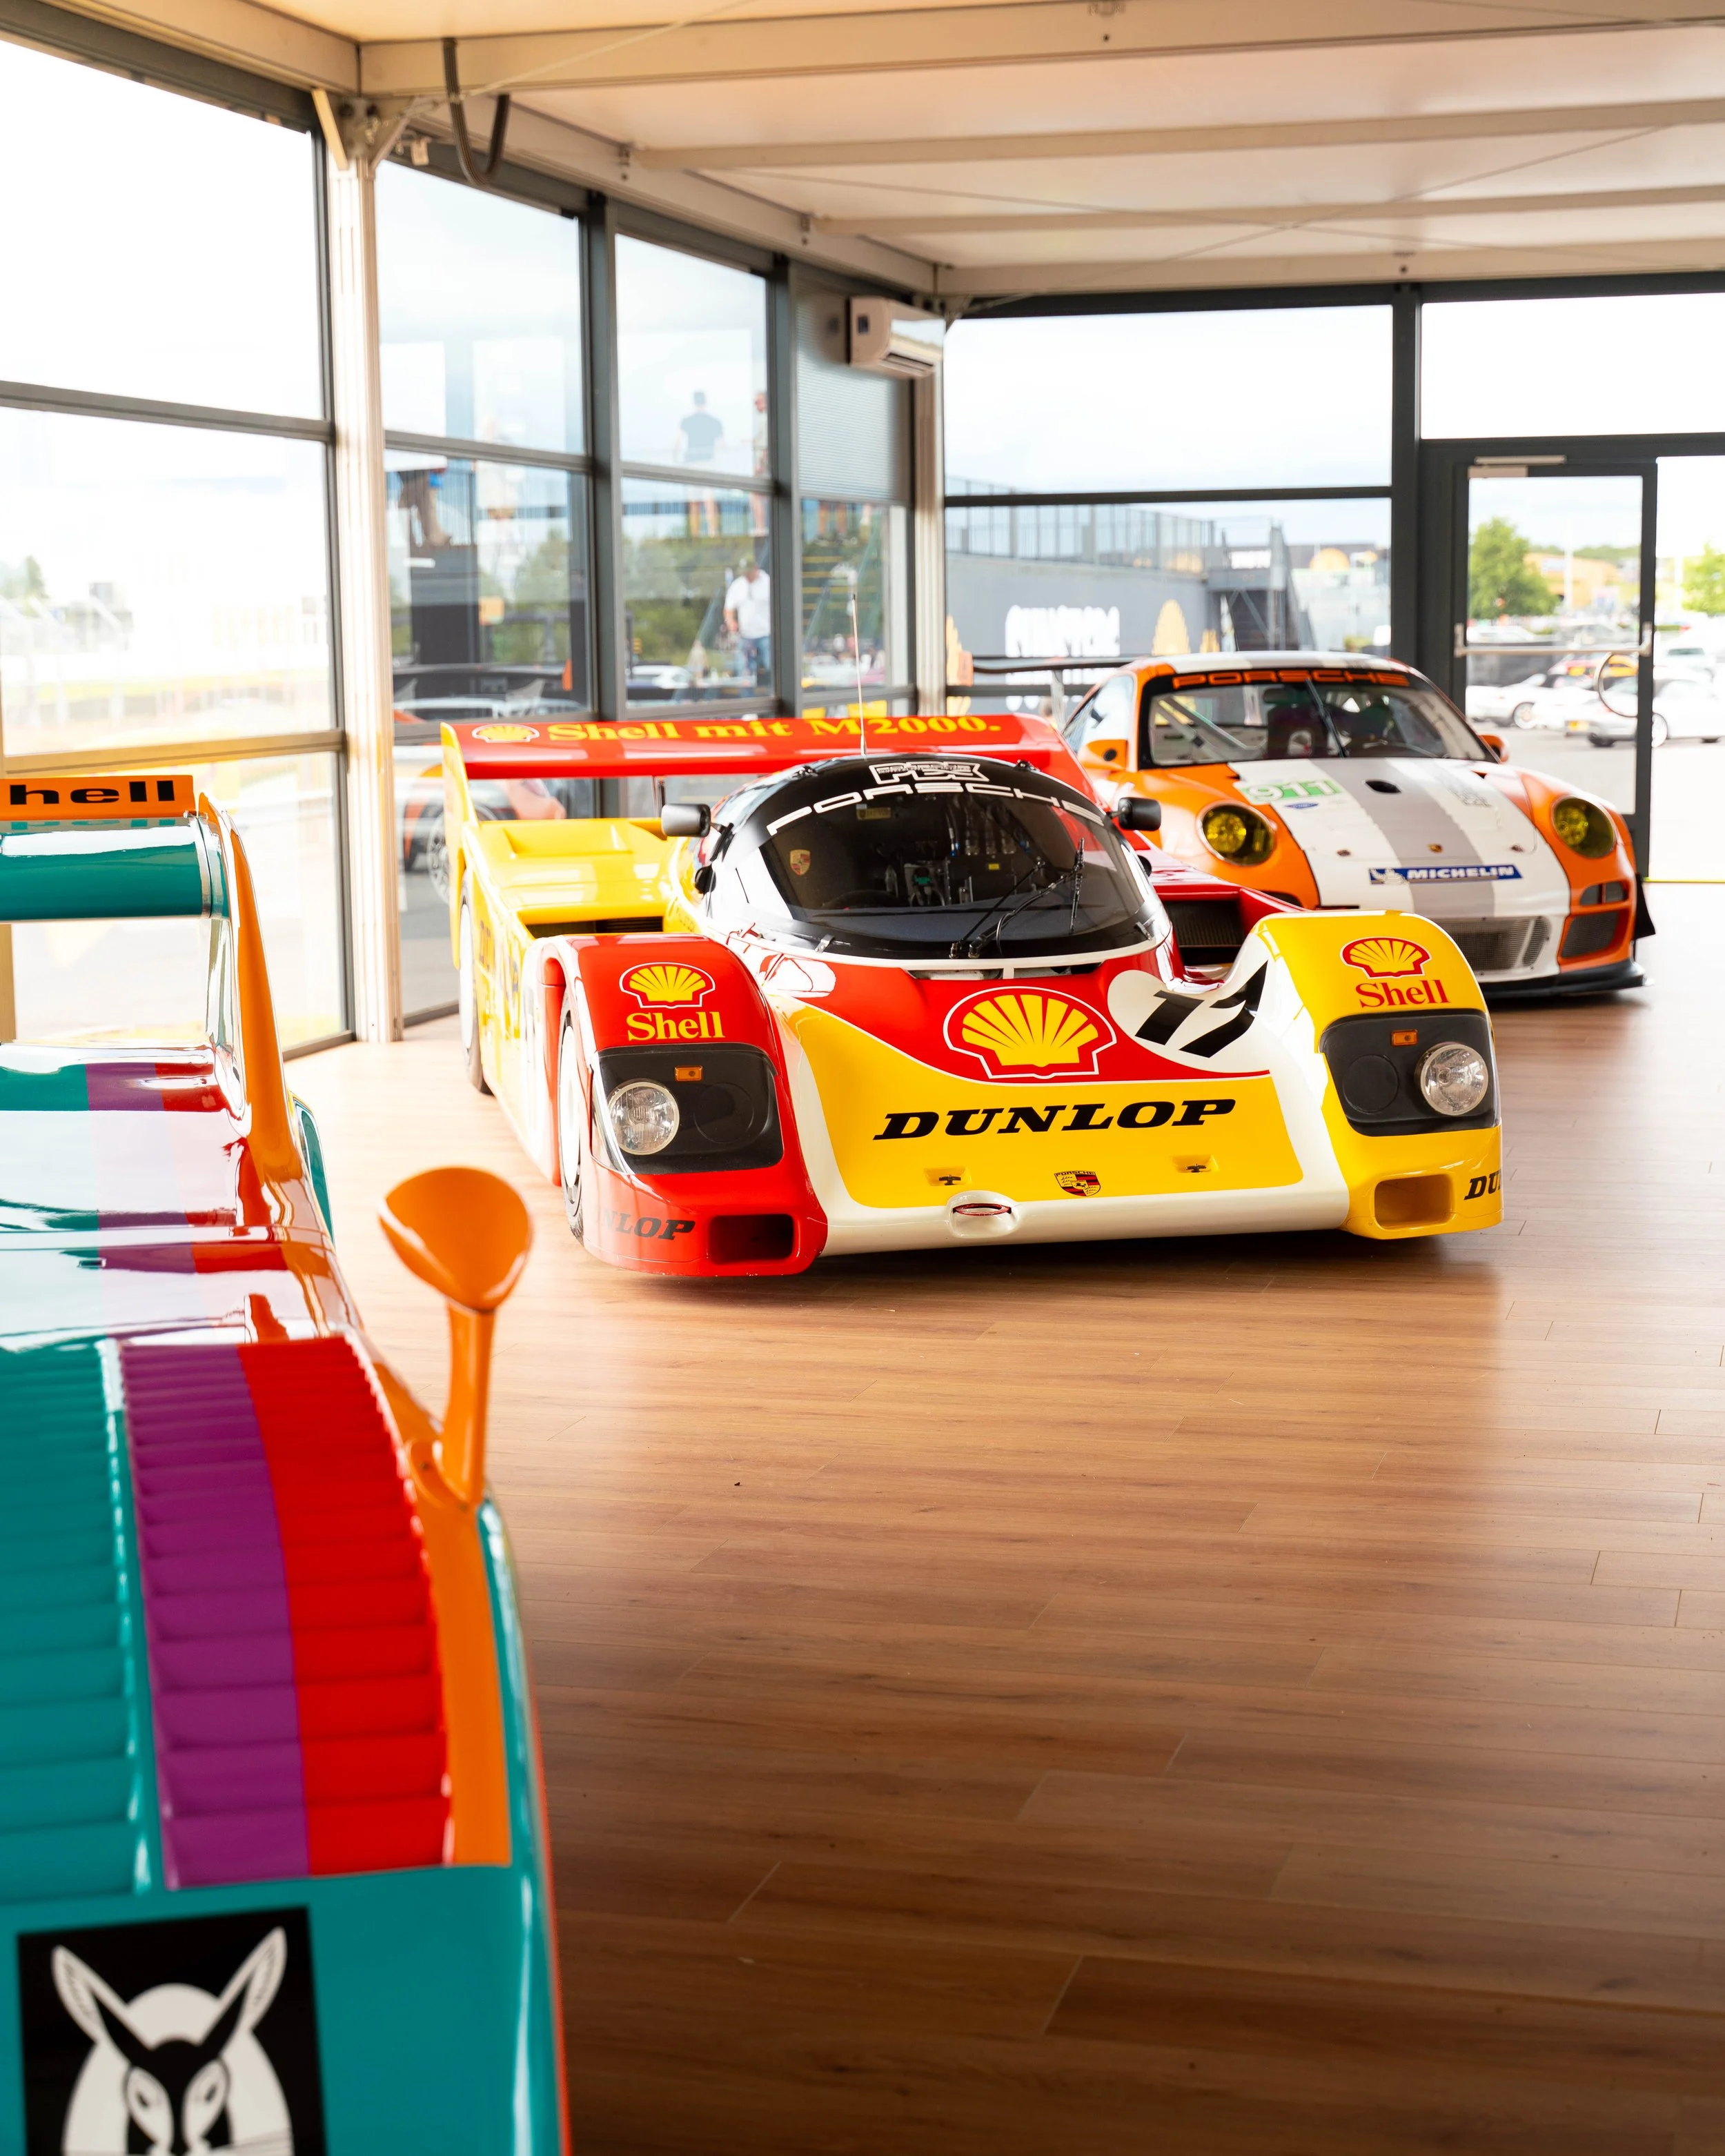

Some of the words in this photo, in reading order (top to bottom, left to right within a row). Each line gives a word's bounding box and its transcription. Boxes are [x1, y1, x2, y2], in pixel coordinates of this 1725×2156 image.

[1172, 669, 1410, 689] PORSCHE
[548, 722, 681, 741] Shell
[693, 720, 793, 738] mit
[1247, 780, 1337, 802] 911
[767, 782, 1104, 836] PORSCHE
[1407, 866, 1515, 880] MICHELIN
[1355, 980, 1450, 1008] Shell
[627, 1011, 725, 1041] Shell
[872, 1098, 1236, 1140] DUNLOP
[1463, 1169, 1501, 1200] DU
